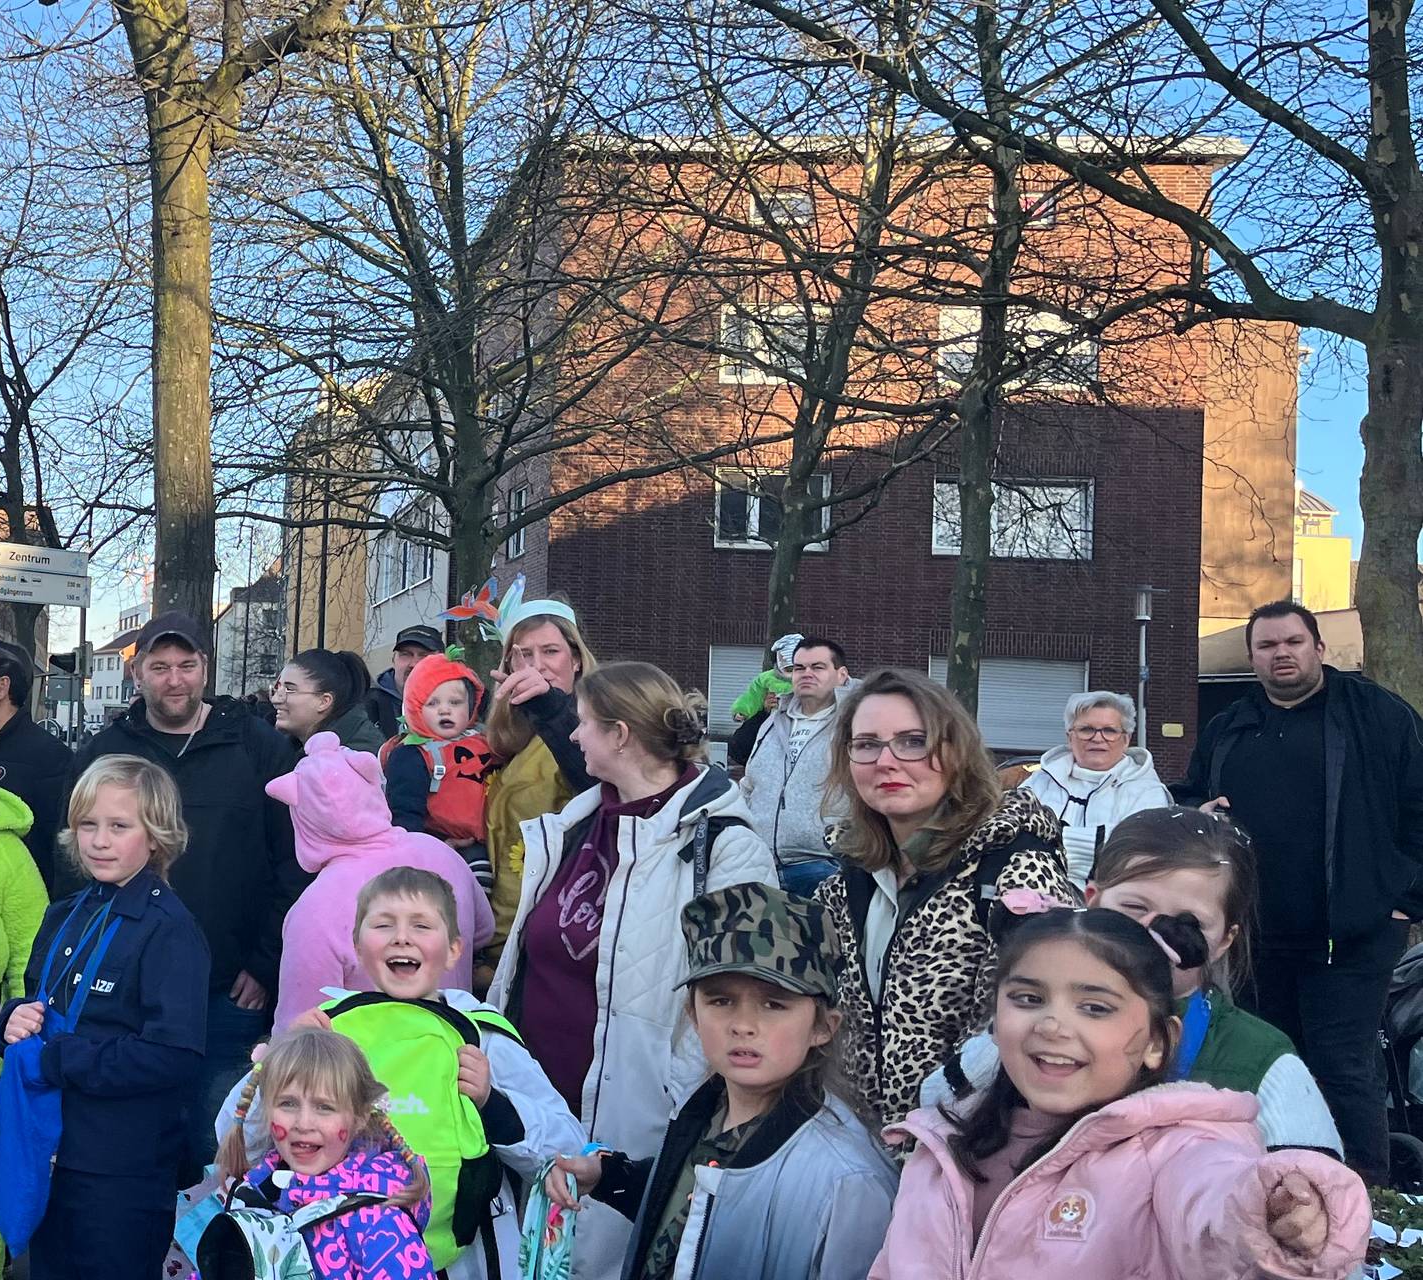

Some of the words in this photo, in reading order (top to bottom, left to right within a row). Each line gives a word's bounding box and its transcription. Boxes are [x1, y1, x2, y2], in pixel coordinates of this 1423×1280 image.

[9, 551, 50, 565] Zentrum
[696, 844, 705, 874] CASUAL
[73, 973, 115, 993] PLIZEI
